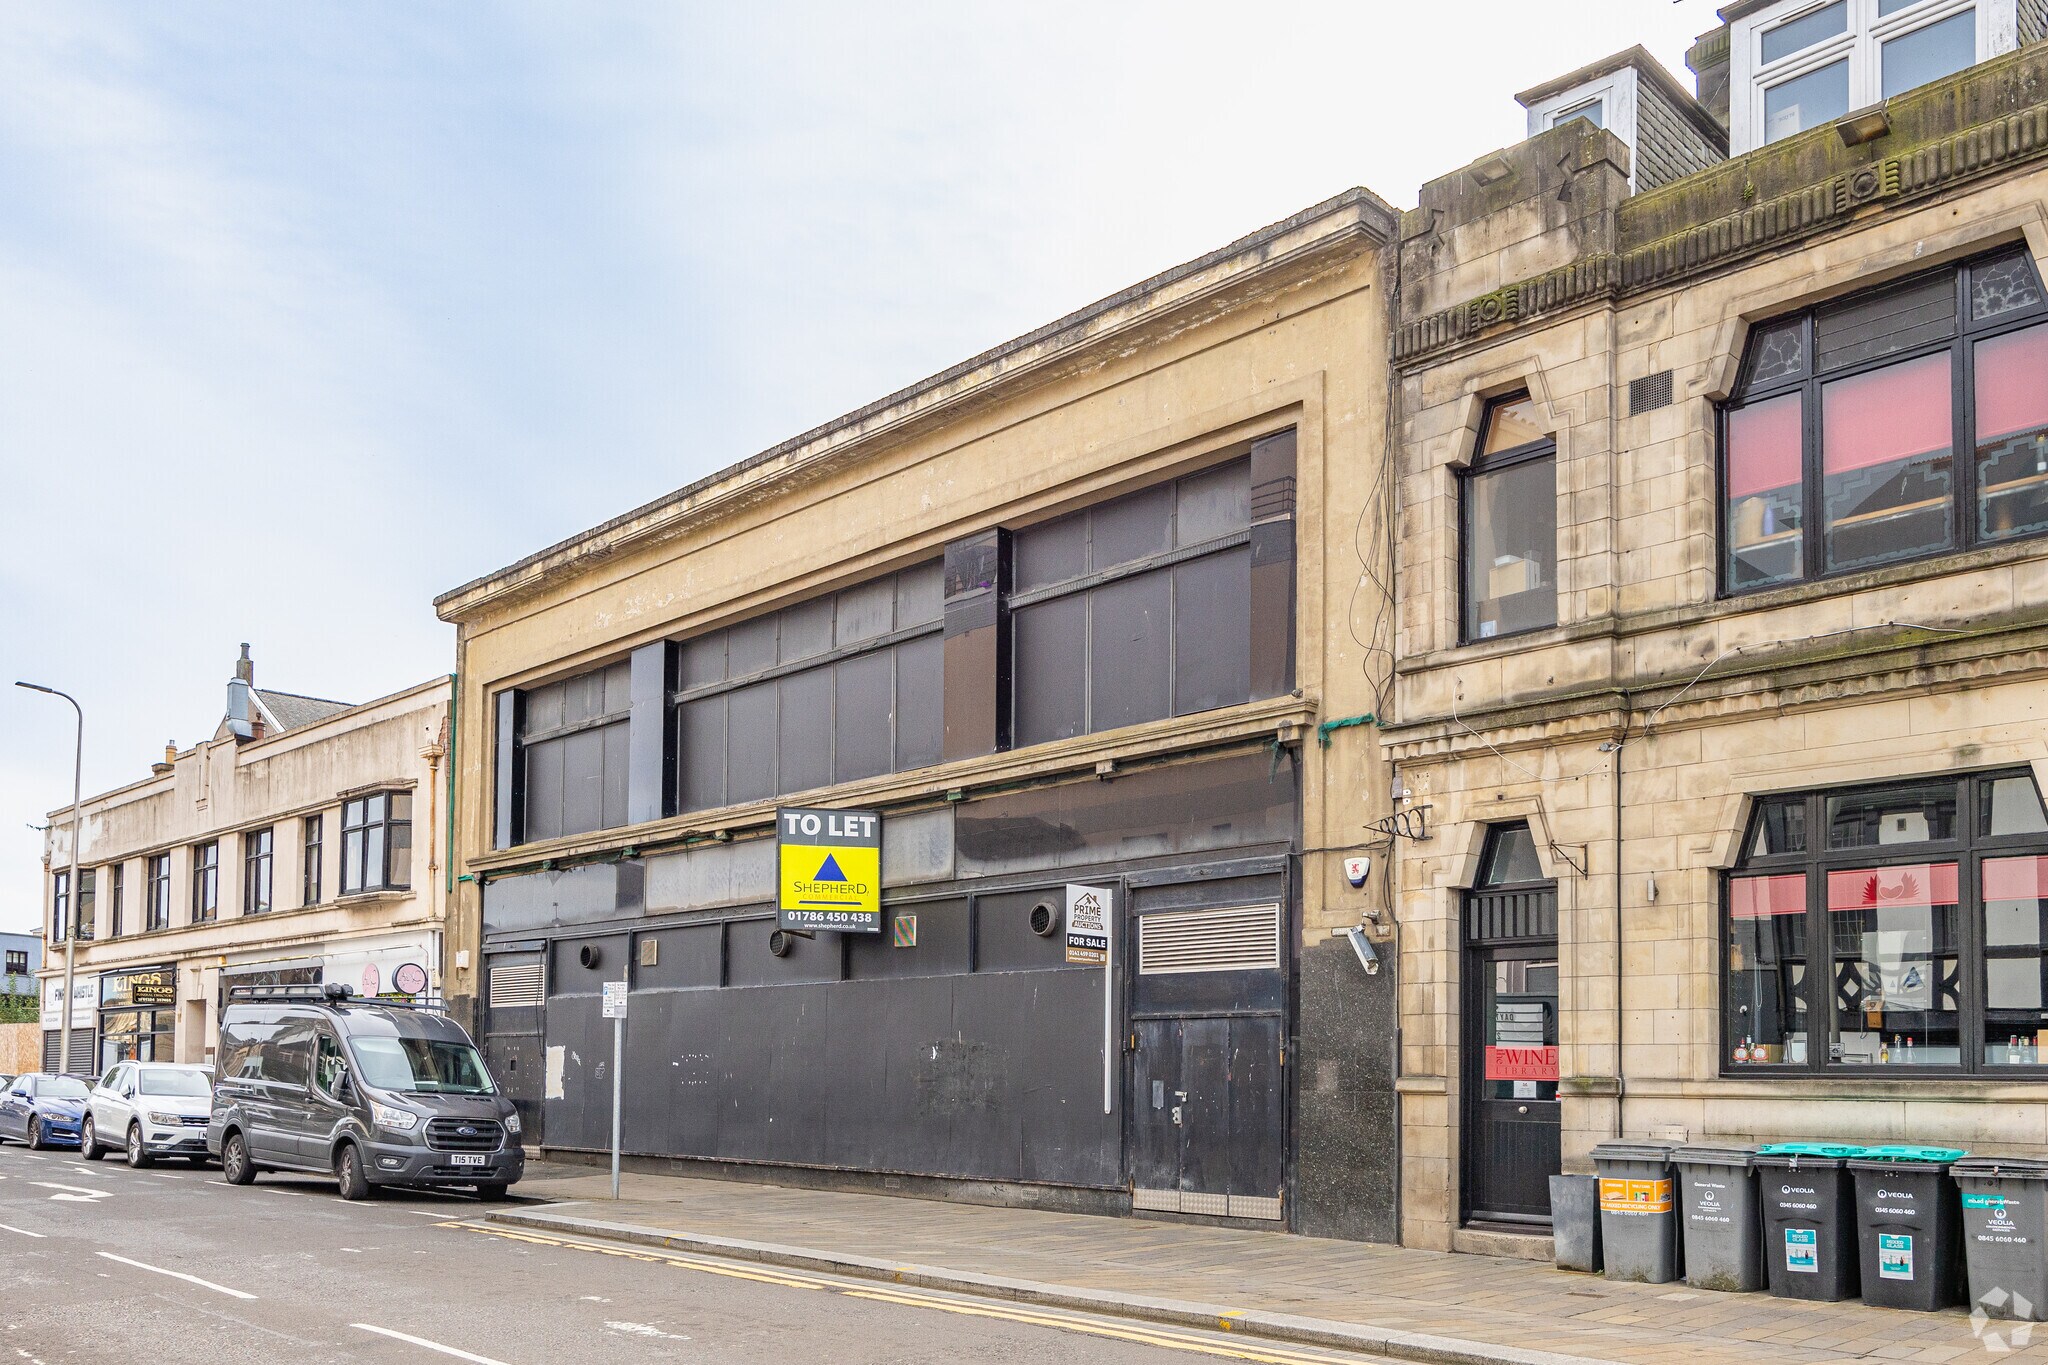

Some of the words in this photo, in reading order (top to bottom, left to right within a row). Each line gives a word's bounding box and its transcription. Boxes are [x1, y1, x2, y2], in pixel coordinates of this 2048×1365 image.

[784, 813, 821, 836] TO
[829, 815, 876, 838] LET
[793, 881, 867, 894] SHEPHERD
[1074, 904, 1101, 916] PRIME
[787, 911, 824, 921] 01786
[826, 912, 848, 922] 450
[850, 913, 872, 923] 438
[1074, 914, 1101, 922] PROPERTY
[804, 922, 856, 930] www.shepherd.co.uk
[1074, 921, 1102, 930] AUCTIONS
[1069, 936, 1085, 946] FOR
[1086, 938, 1106, 948] SALE
[113, 973, 161, 992] KINGS
[137, 986, 173, 994] KINGS
[1505, 1048, 1556, 1065] WINE
[1496, 1066, 1557, 1075] LIBRARY
[468, 1156, 482, 1164] TVE
